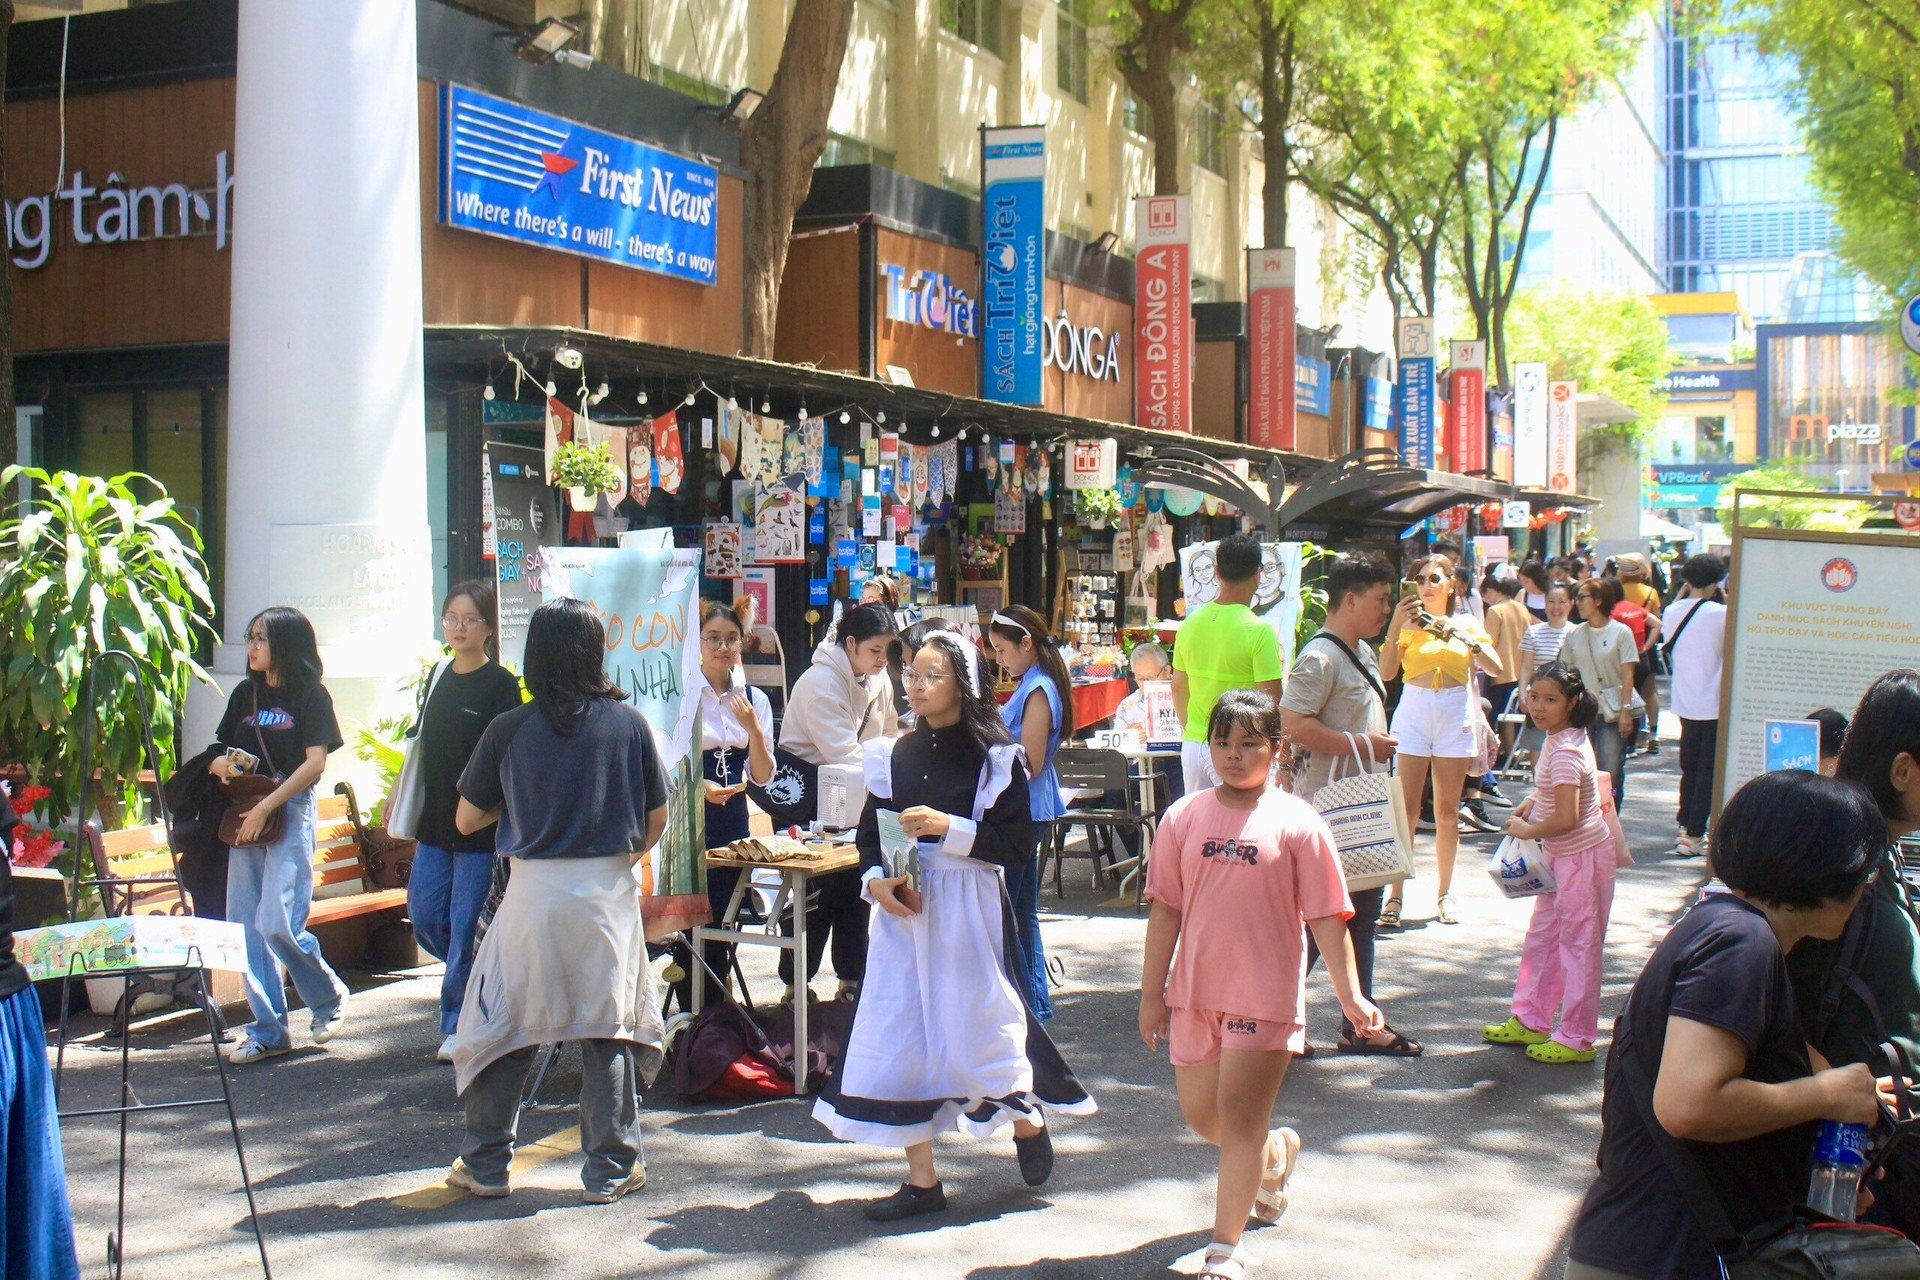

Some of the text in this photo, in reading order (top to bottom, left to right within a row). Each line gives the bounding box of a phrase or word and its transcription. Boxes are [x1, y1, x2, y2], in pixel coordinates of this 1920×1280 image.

[579, 147, 713, 227] First News
[456, 191, 511, 225] Where
[514, 207, 568, 239] there's
[572, 225, 581, 242] a
[586, 227, 613, 250] will
[628, 234, 674, 264] there's
[677, 250, 686, 267] a
[689, 253, 715, 278] way
[1171, 249, 1181, 294] COMPANY
[1171, 297, 1181, 324] STOCK
[1142, 251, 1168, 428] SÁCH ĐÔNG A
[992, 328, 1016, 393] SÁCH
[1172, 348, 1181, 389] CULTURAL
[1402, 363, 1419, 385] TRẺ
[1673, 374, 1720, 388] Health
[1402, 388, 1418, 412] BẢN
[1402, 415, 1418, 443] XUẤT
[1827, 420, 1881, 444] plaza
[1659, 471, 1711, 483] VPBank
[497, 518, 524, 531] COMBO
[497, 537, 524, 559] SÁCH
[498, 559, 521, 582] GIẤY
[631, 604, 686, 652] CON
[630, 651, 680, 706] NHÀ
